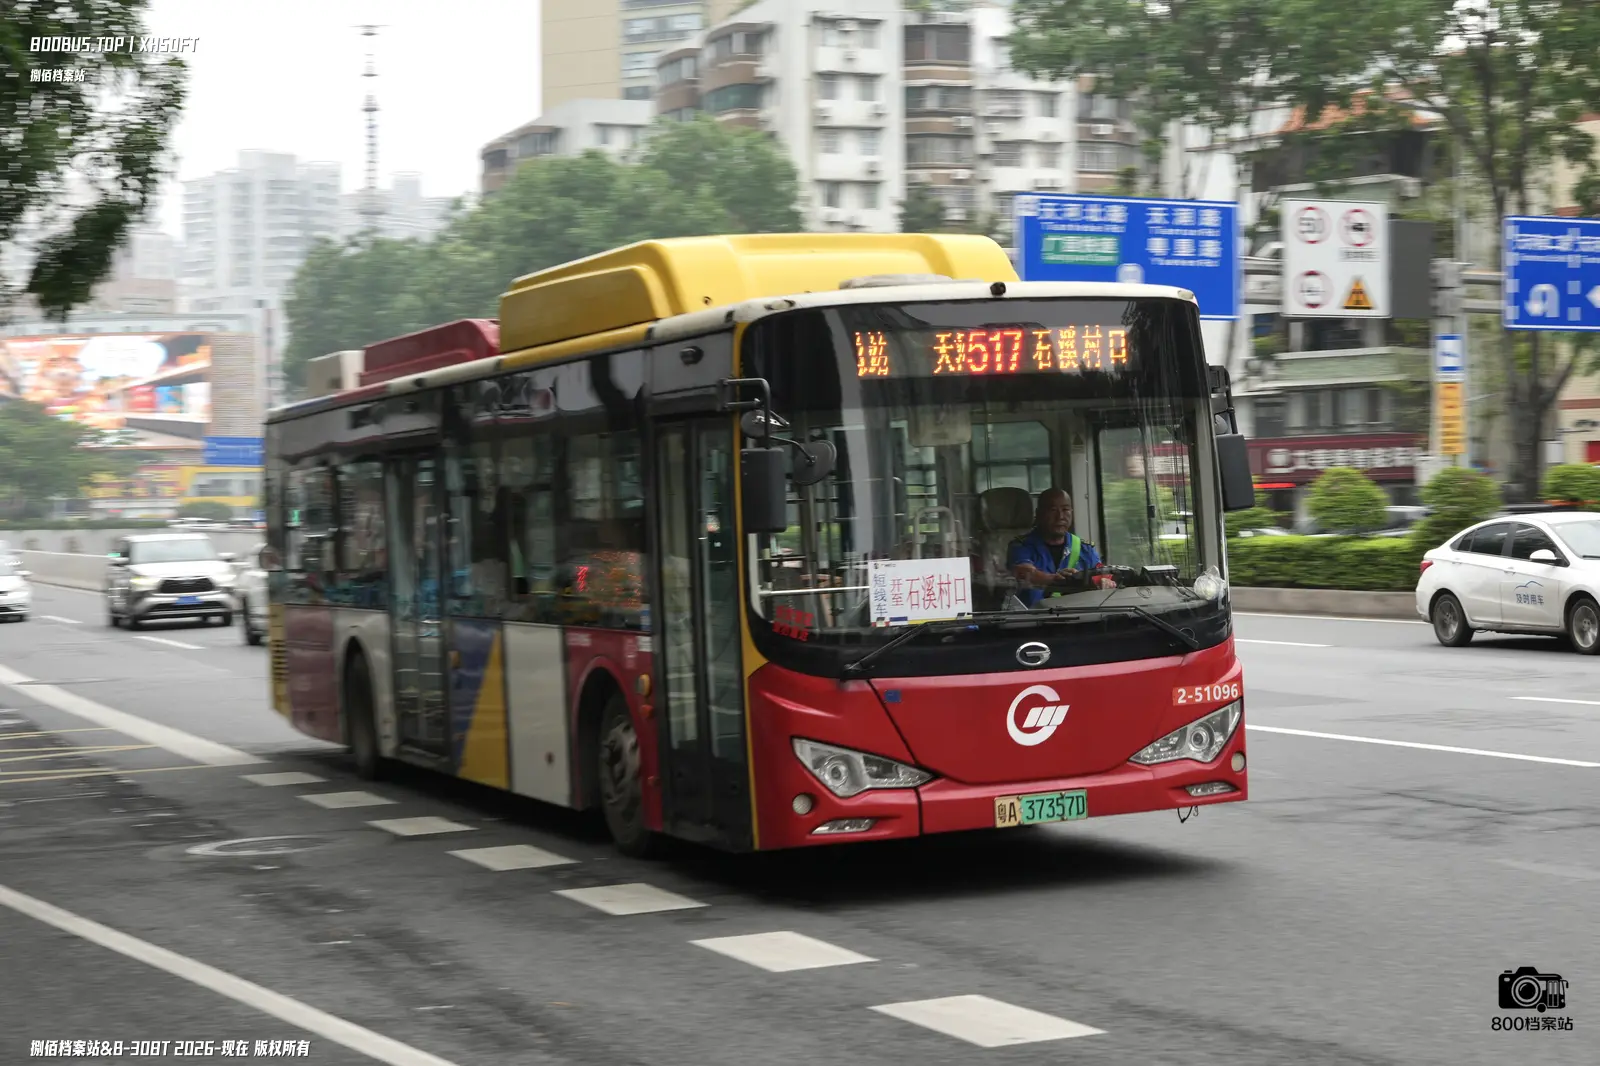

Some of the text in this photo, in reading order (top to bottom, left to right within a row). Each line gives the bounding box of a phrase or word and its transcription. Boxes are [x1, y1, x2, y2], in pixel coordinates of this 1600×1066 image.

[967, 330, 1022, 372] 517
[1032, 324, 1127, 370] 石溪村口
[874, 573, 888, 617] 短线车
[890, 577, 904, 607] 开至
[905, 573, 971, 610] 石溪村口
[1177, 683, 1239, 704] 2-51096
